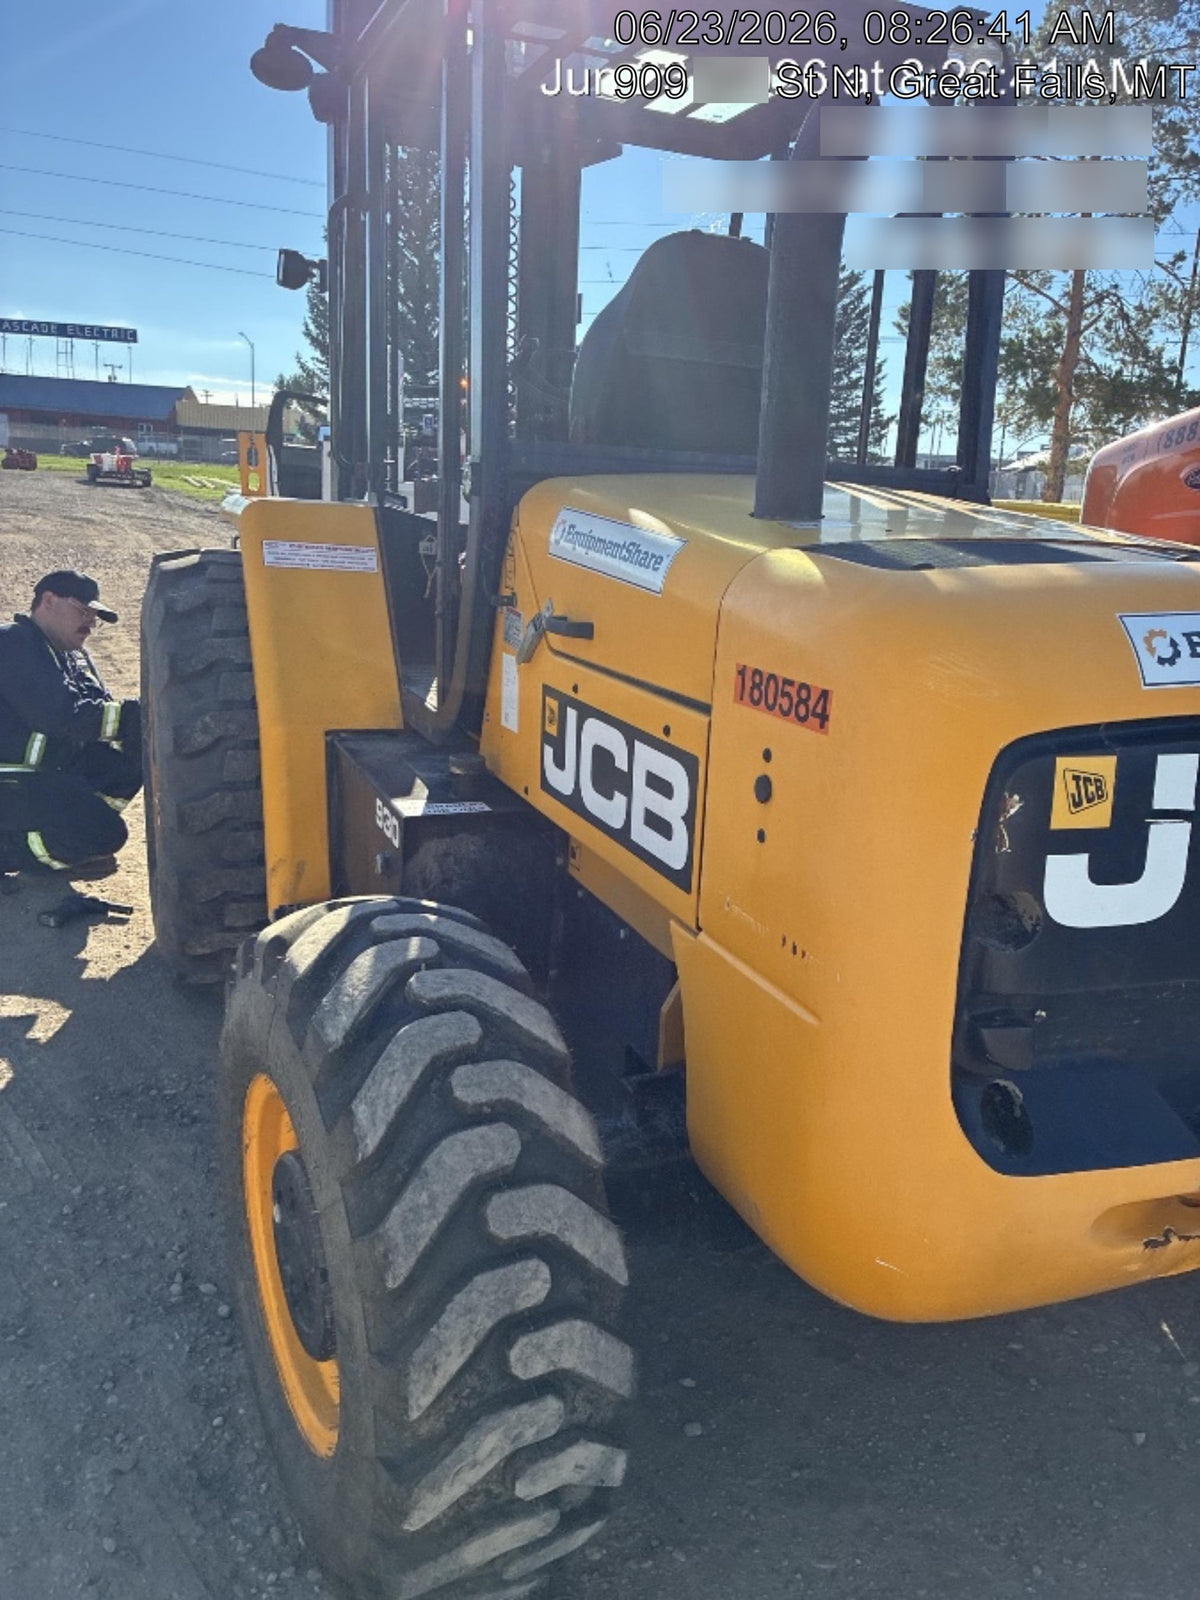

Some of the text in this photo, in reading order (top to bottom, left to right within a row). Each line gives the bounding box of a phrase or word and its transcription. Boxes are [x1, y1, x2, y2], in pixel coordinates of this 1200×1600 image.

[67, 325, 135, 340] ELECTRIC
[564, 523, 665, 572] EquipmentShare
[736, 664, 830, 730] 180584
[543, 706, 690, 870] JCB
[1070, 773, 1105, 809] JCB
